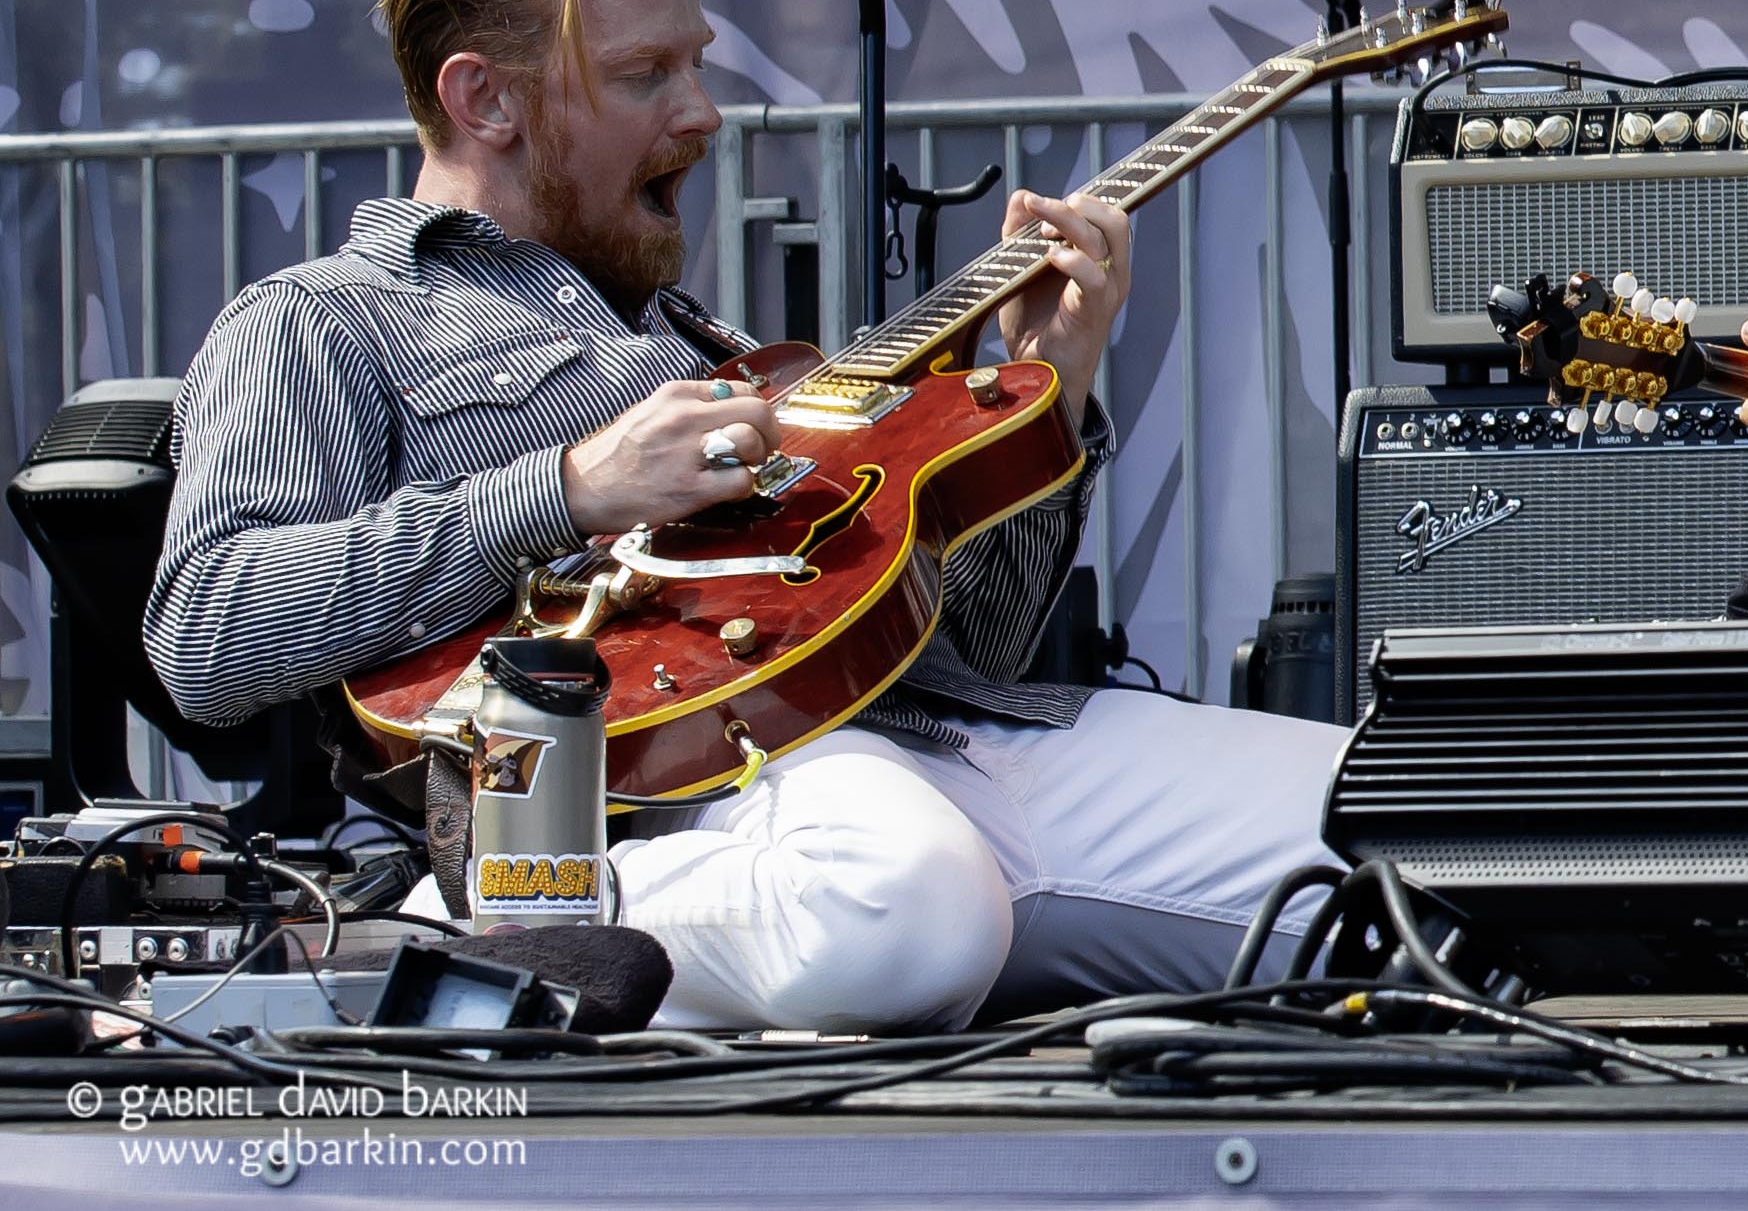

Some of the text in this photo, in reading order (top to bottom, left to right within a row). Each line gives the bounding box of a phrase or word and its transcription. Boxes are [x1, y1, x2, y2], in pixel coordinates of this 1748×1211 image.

[1377, 441, 1414, 451] NORMAL
[1596, 436, 1631, 445] VIBRATO
[1396, 484, 1521, 571] Fender
[480, 858, 598, 899] SMASH
